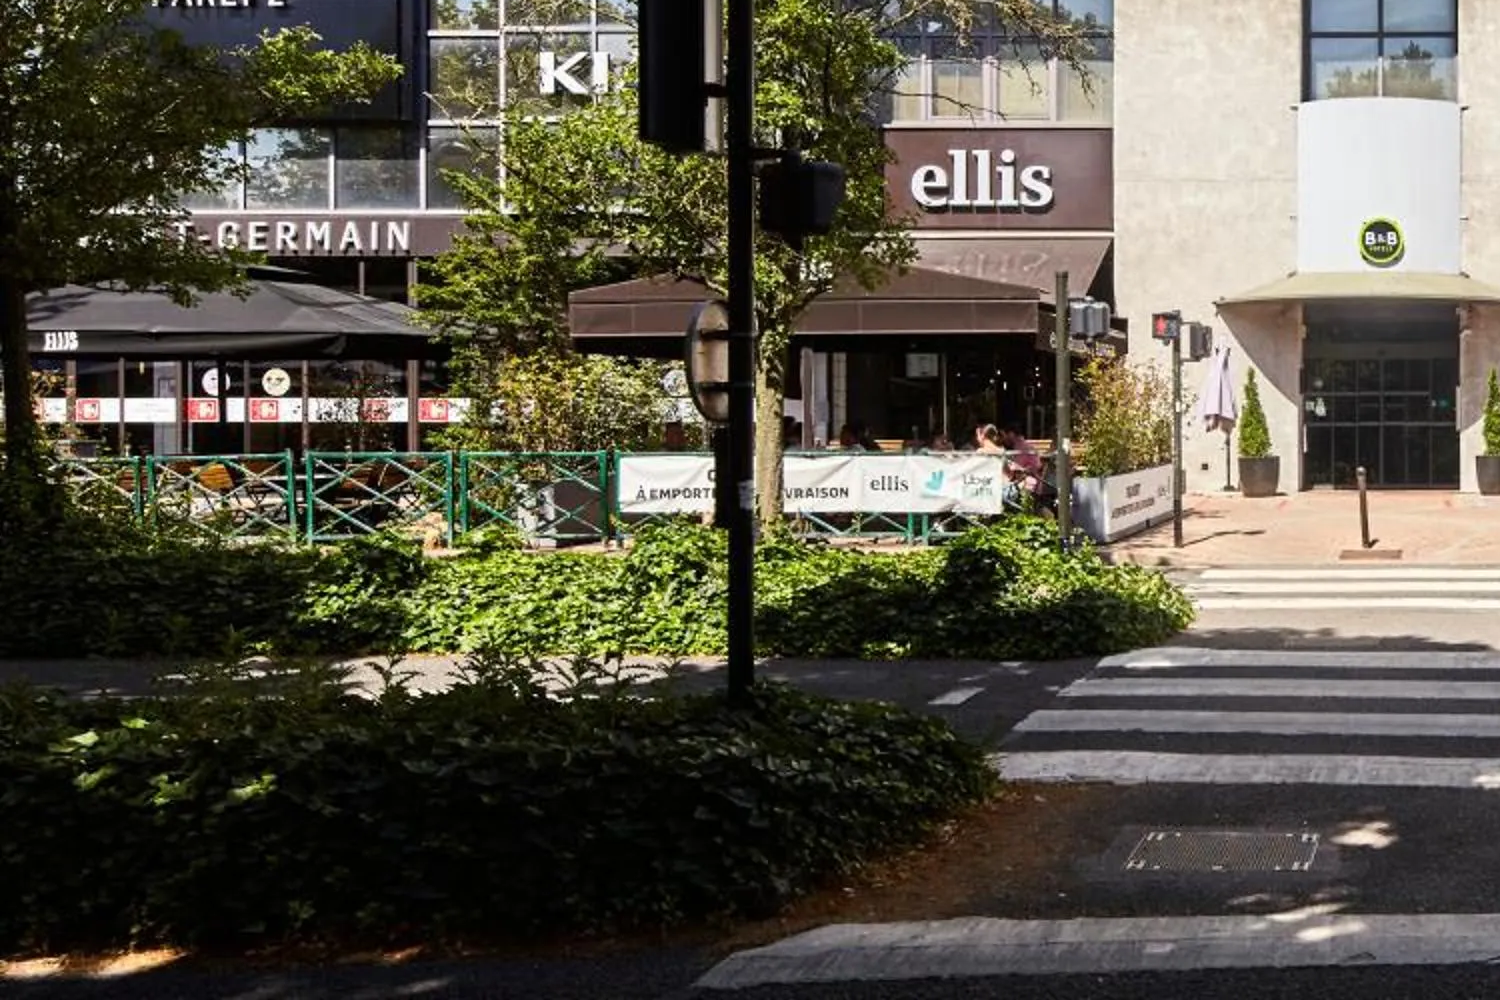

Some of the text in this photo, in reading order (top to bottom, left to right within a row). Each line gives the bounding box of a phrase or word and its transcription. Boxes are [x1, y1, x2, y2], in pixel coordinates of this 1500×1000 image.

[911, 149, 1053, 206] ellis
[143, 220, 411, 251] T-GERMAIN
[783, 486, 849, 500] VRAISON
[869, 475, 909, 492] ellis
